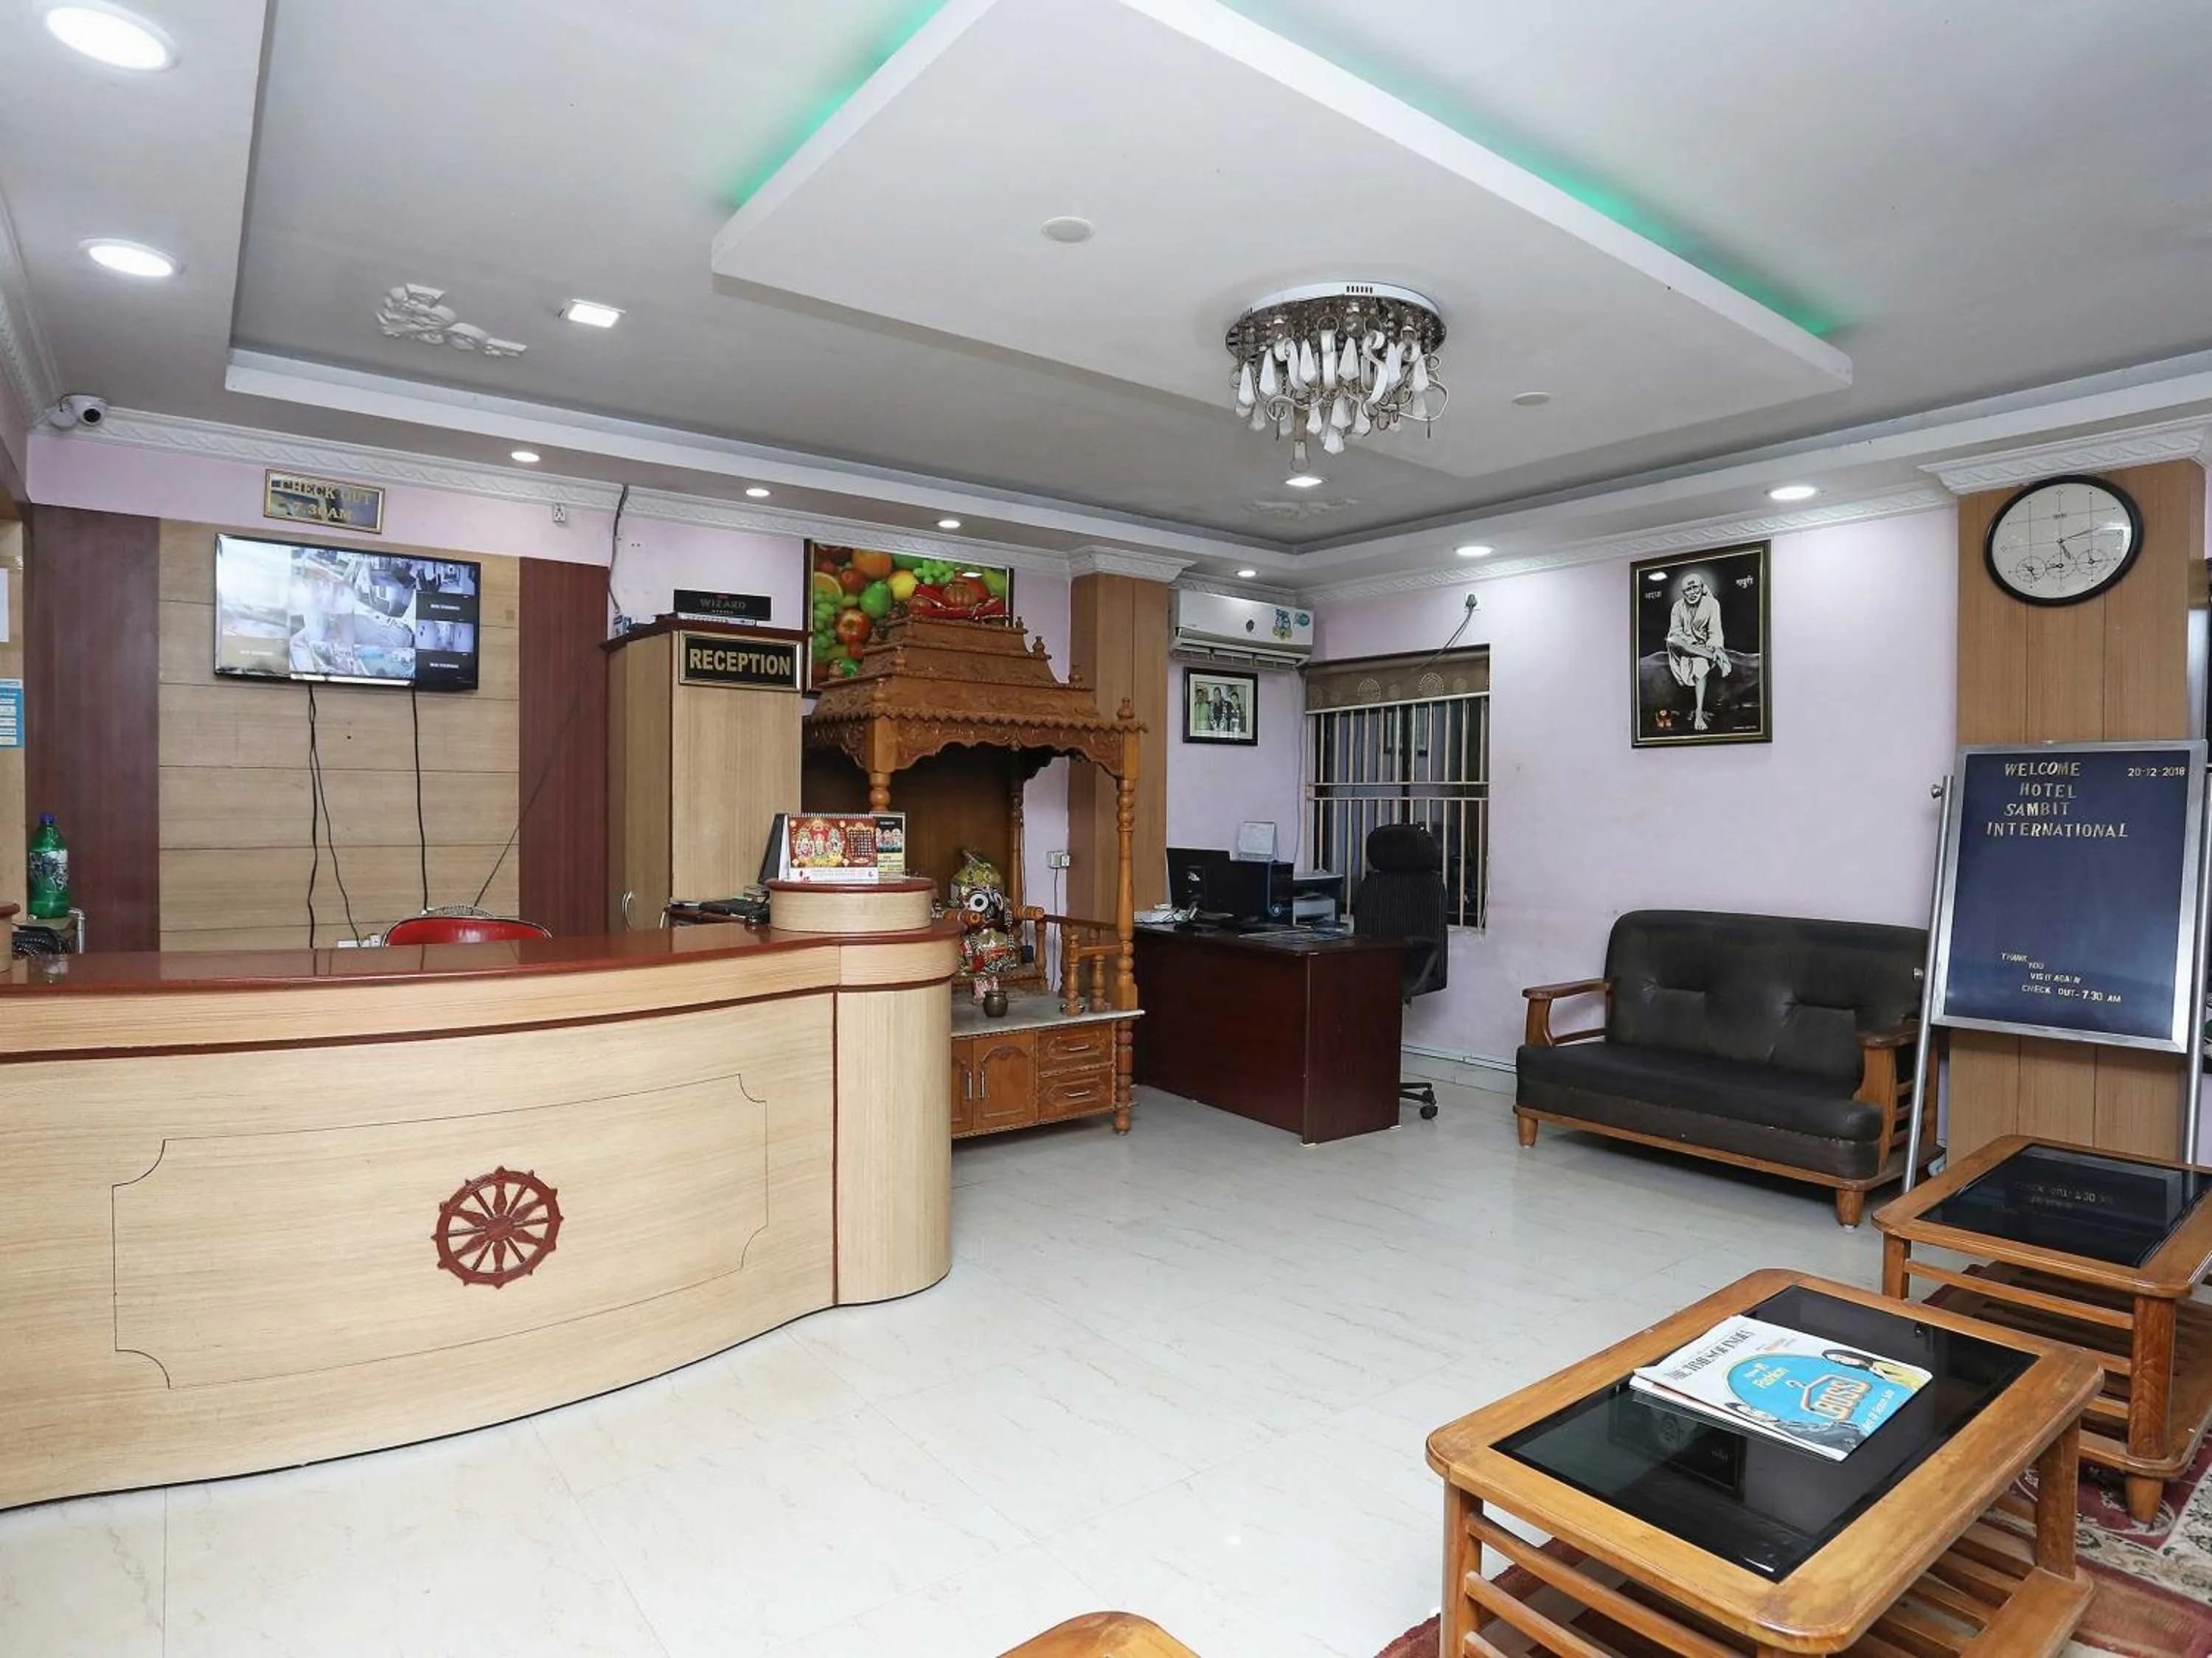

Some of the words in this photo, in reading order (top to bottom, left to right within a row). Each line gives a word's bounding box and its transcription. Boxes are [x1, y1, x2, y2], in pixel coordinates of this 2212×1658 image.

[700, 598, 746, 610] WIZARD
[689, 648, 791, 676] RECEPTION
[2005, 762, 2081, 777] WELCOME
[2020, 782, 2076, 798] HOTEL
[2003, 802, 2070, 816] SAMBIT
[1987, 822, 2129, 838] INTERNATIONAL
[2030, 973, 2052, 981] VISIT
[2053, 974, 2081, 984] AGAIN
[2021, 985, 2051, 994] CHECK
[2107, 994, 2121, 1002] AM
